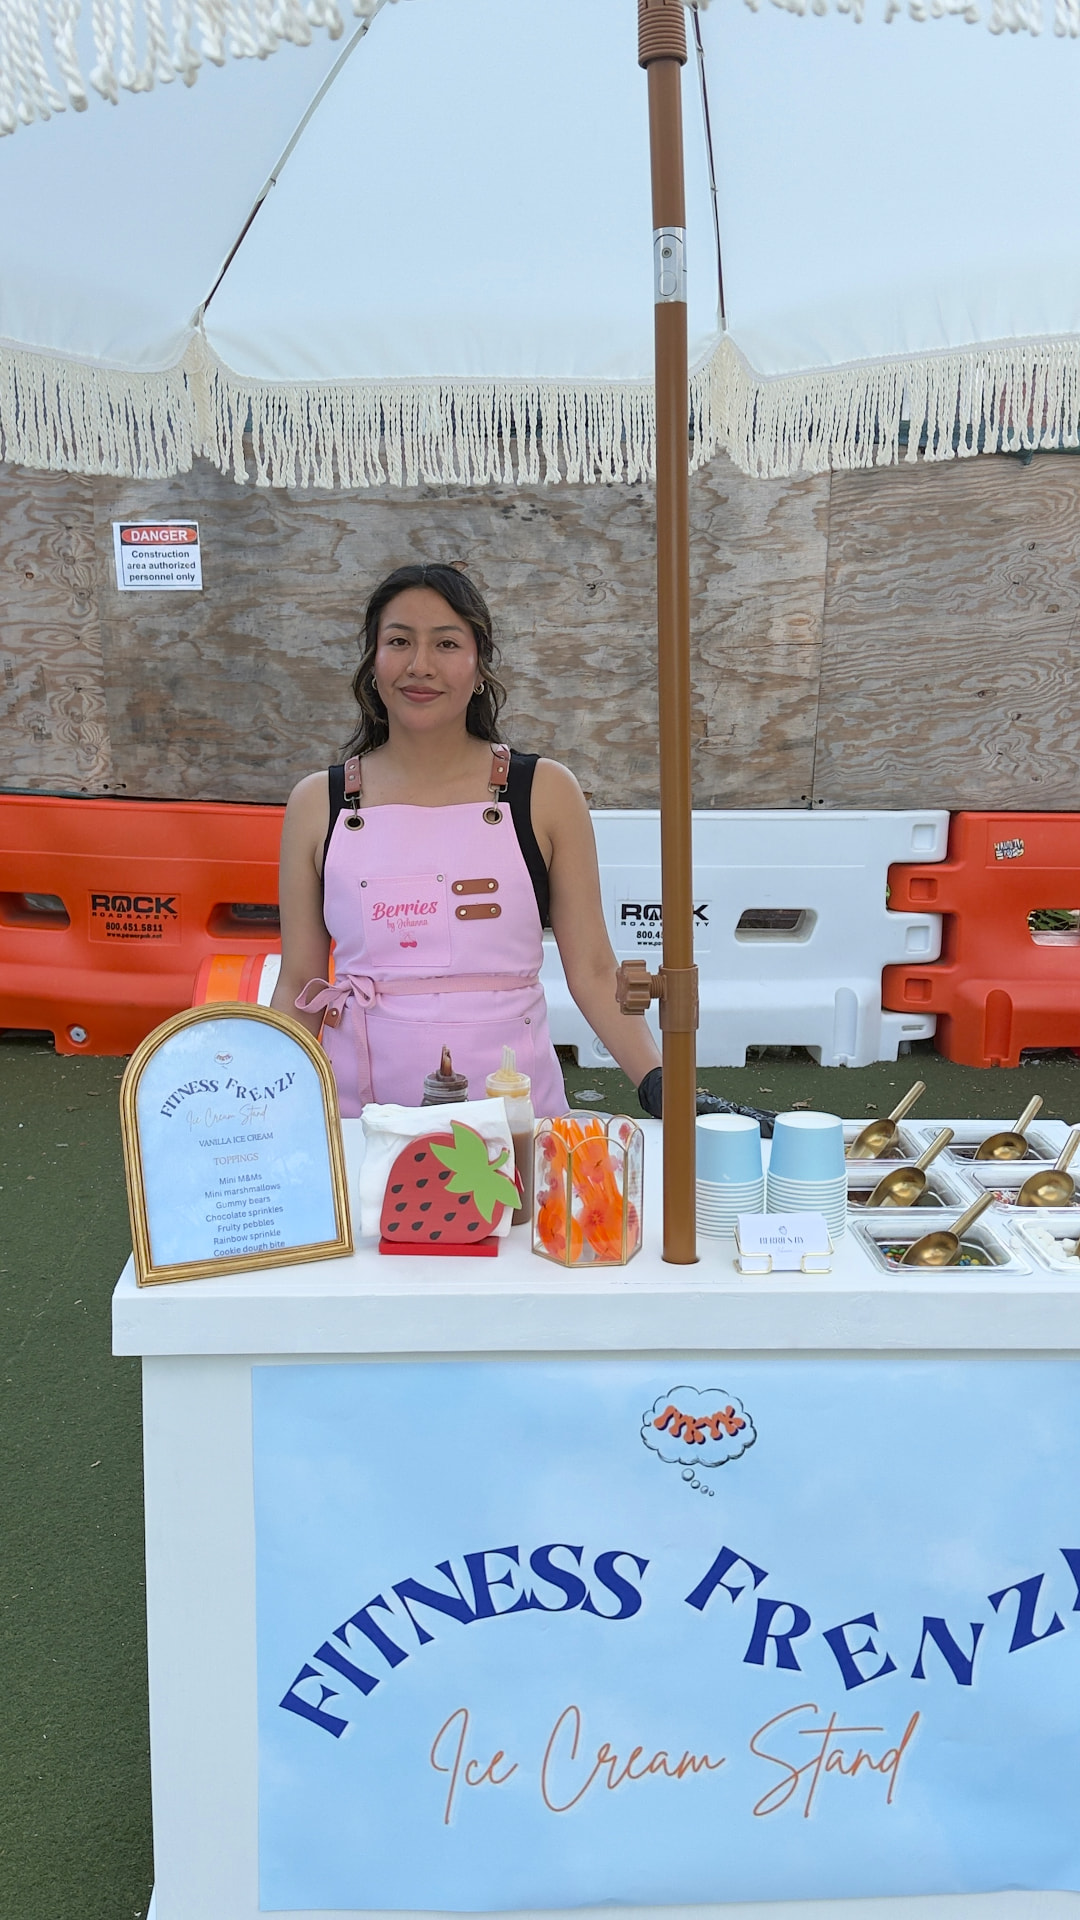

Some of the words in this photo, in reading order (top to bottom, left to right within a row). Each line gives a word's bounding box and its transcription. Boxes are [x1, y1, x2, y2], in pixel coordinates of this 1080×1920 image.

[131, 530, 188, 541] DANGER
[131, 550, 190, 558] Construction
[149, 561, 196, 569] authorized
[129, 573, 174, 582] personnel
[176, 573, 195, 581] only
[91, 894, 178, 914] ROCK
[371, 899, 438, 921] Berries
[621, 903, 709, 921] ROK
[105, 922, 163, 932] 800.451.5811
[386, 919, 396, 933] by
[397, 918, 428, 930] Johanna
[160, 1079, 219, 1118] FITNESS
[225, 1072, 296, 1101] FRENZY
[186, 1110, 202, 1132] Ice
[204, 1107, 236, 1128] Cream
[239, 1103, 268, 1126] Stand
[198, 1137, 232, 1147] VANILLA
[233, 1135, 246, 1143] ICE
[246, 1132, 274, 1142] CREAM
[213, 1152, 259, 1165] TOPPINGS
[219, 1176, 236, 1185] Mini
[237, 1173, 262, 1182] M&Ms
[204, 1190, 222, 1199] Mini
[224, 1183, 281, 1196] marshmallows
[216, 1200, 247, 1209] Gummy
[248, 1196, 271, 1205] bears
[205, 1211, 247, 1222] Chocolate
[248, 1205, 284, 1217] sprinkles
[217, 1224, 241, 1233] Fruity
[243, 1219, 275, 1230] pebbles
[213, 1235, 248, 1245] Rainbow
[250, 1229, 281, 1240] sprinkle
[213, 1248, 241, 1257] Cookie
[243, 1243, 268, 1252] dough
[269, 1241, 285, 1249] bite
[279, 1543, 650, 1739] FITNESS
[430, 1707, 518, 1825] Ice
[541, 1705, 727, 1813] Cream
[750, 1703, 921, 1819] Stand
